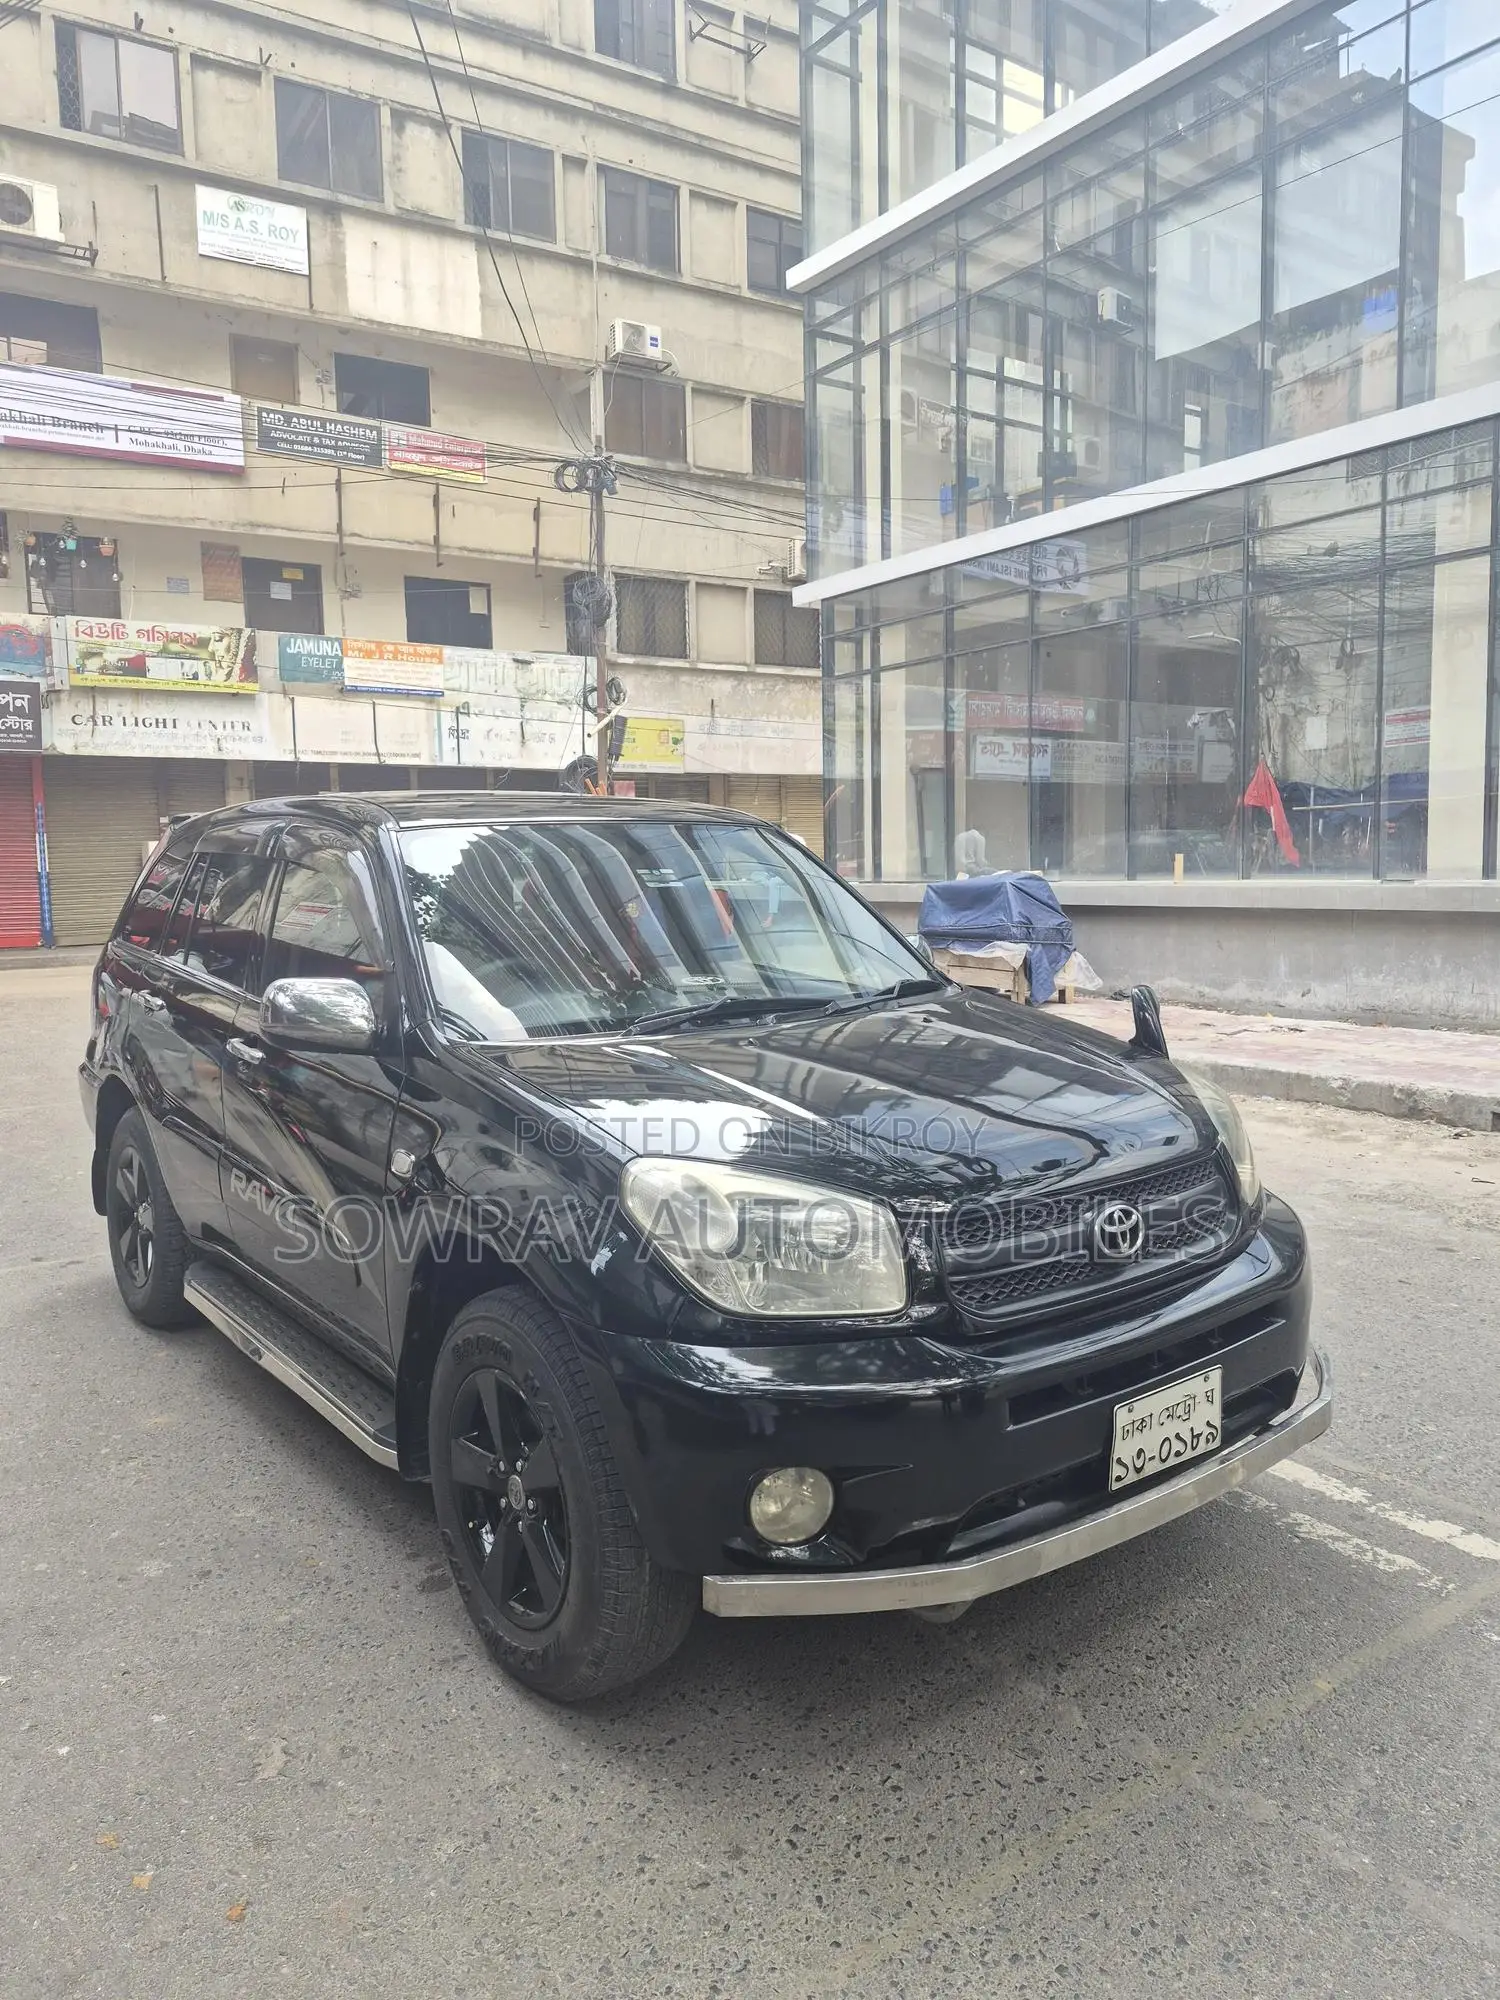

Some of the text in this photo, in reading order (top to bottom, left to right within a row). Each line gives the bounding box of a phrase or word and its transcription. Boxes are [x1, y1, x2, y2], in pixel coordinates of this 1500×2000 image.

[203, 210, 229, 229] M/S
[234, 217, 263, 236] A.S.
[268, 222, 300, 243] ROY
[261, 412, 378, 442] MD. ABUL HASHEM
[313, 436, 320, 444] &
[321, 438, 336, 447] TAX
[75, 620, 129, 640] বিউটি
[286, 637, 341, 656] JAMUNA
[301, 656, 338, 669] EYELET
[347, 650, 367, 659] Mr.
[398, 654, 440, 664] House
[71, 713, 113, 727] CAR
[122, 716, 179, 730] LIGHT
[1121, 1412, 1154, 1440] ঢাকা
[1114, 1420, 1219, 1482] ১৩-০১৮৯
